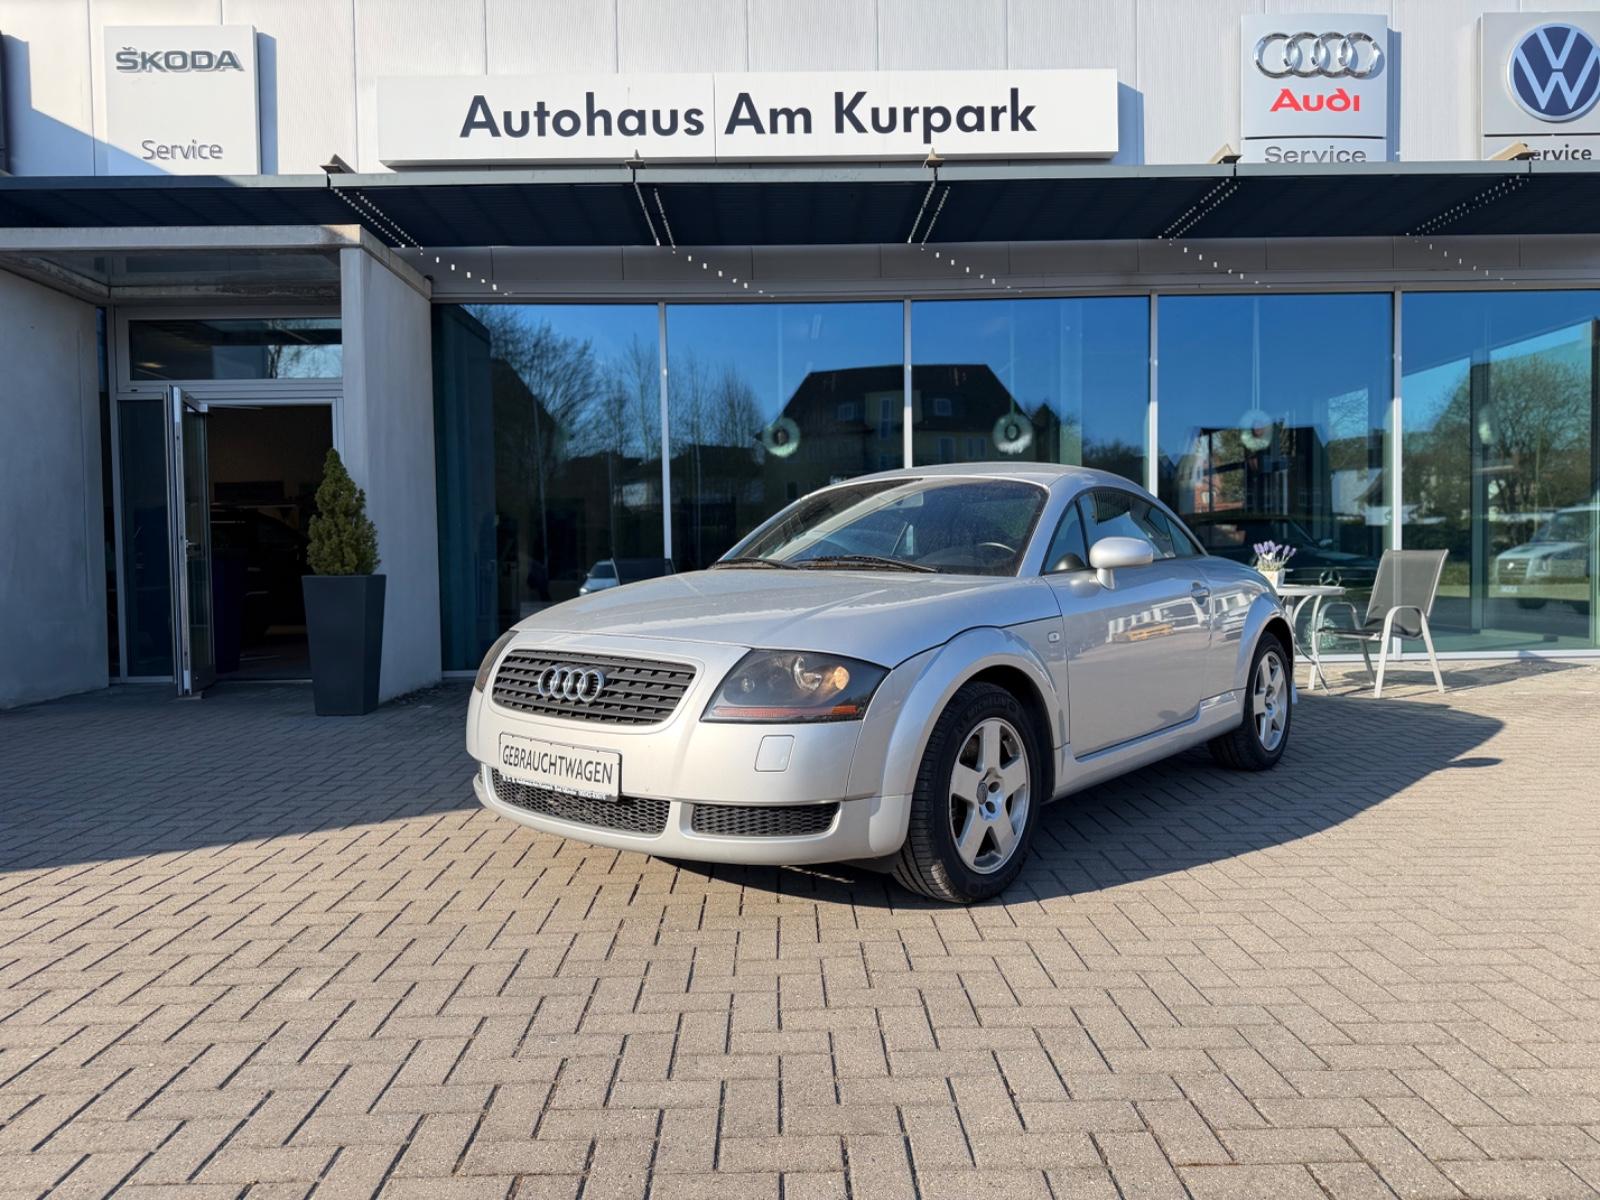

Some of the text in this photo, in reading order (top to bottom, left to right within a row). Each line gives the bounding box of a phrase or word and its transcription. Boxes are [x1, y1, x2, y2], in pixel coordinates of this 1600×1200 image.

[115, 46, 243, 72] ŠKODA
[1271, 88, 1361, 112] Audi
[460, 87, 1037, 145] Autohaus Am Kurpark
[141, 138, 223, 161] Service
[1264, 145, 1367, 163] Service
[1531, 143, 1592, 160] ervice
[502, 744, 613, 784] GEBRAUCHTWAGEN
